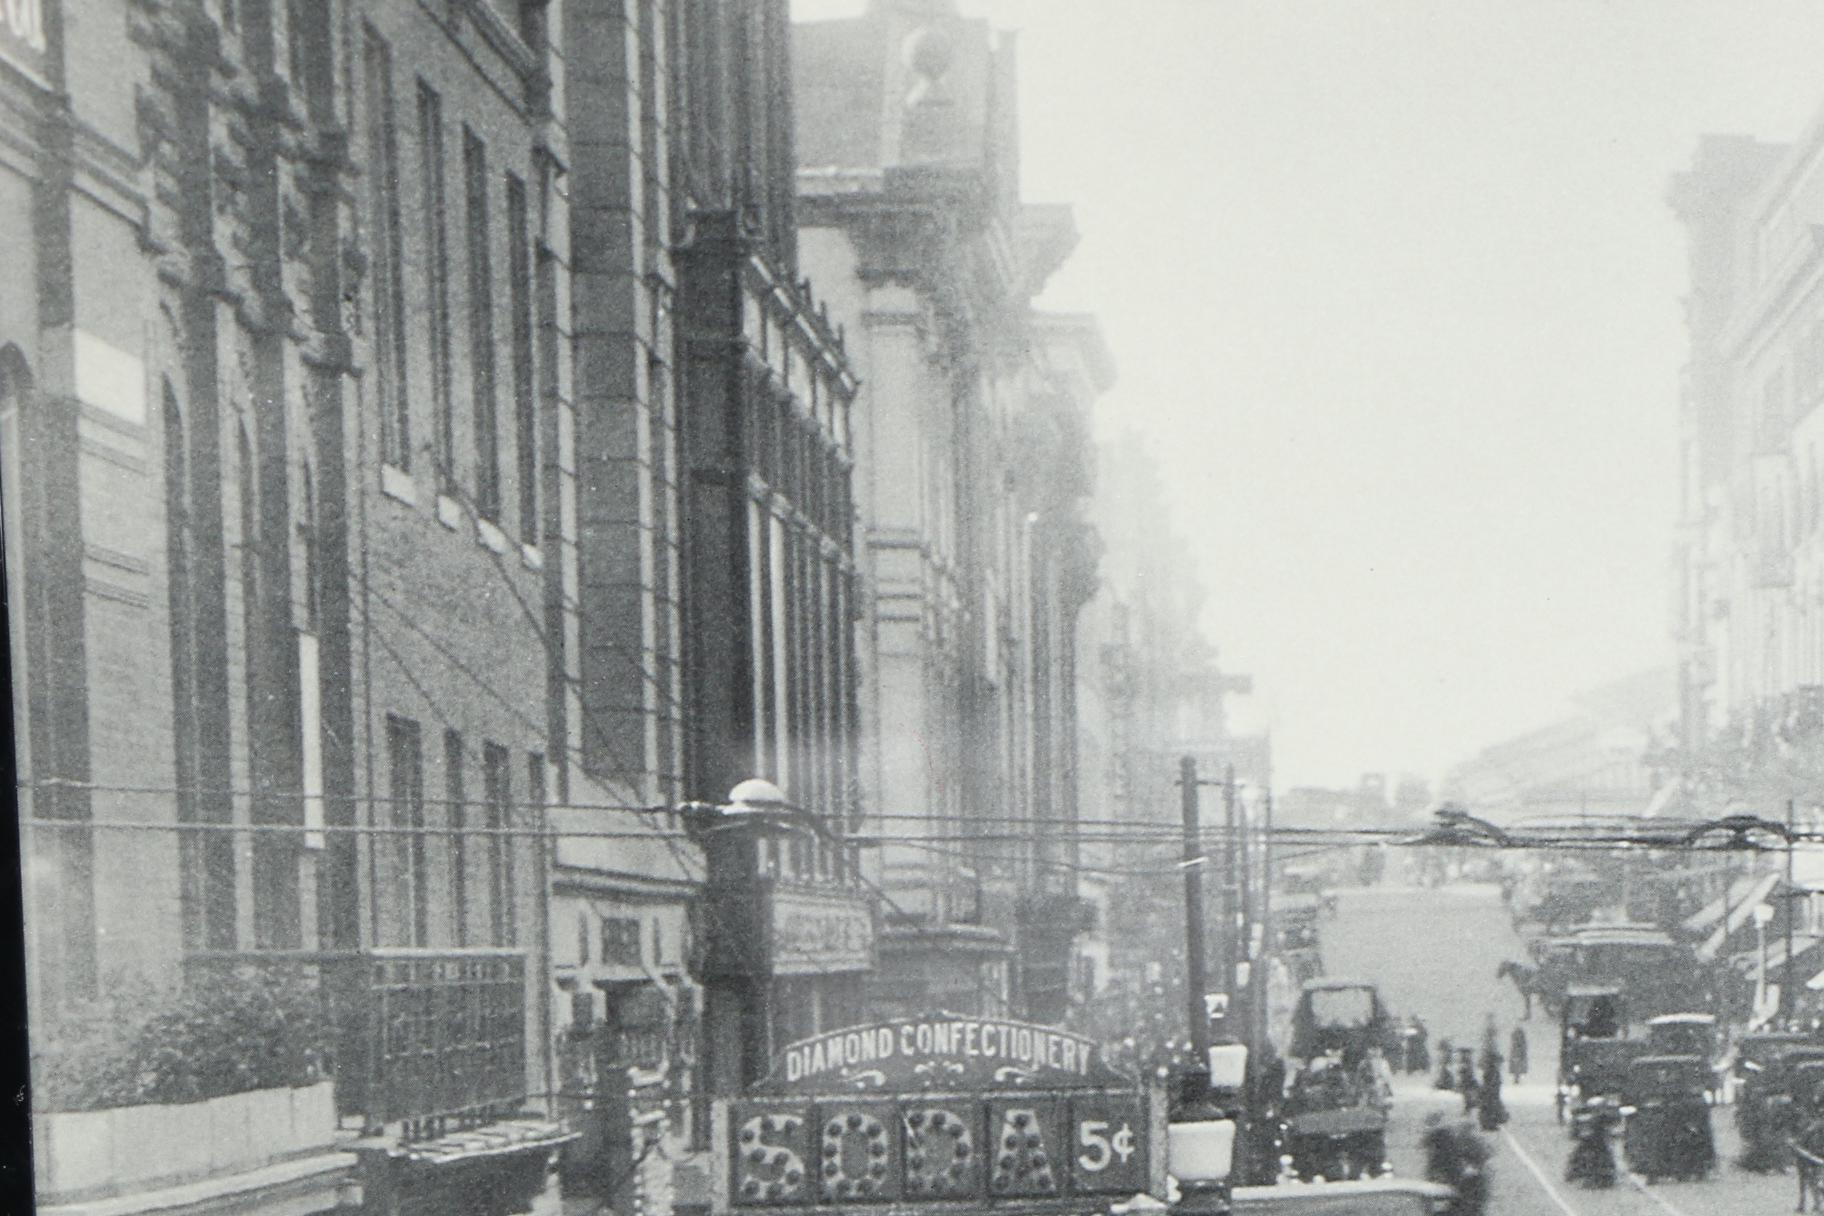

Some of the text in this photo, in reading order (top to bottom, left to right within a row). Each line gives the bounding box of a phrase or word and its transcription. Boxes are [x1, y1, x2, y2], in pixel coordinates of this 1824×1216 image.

[786, 1022, 1091, 1082] DIAMOND CONFECTIONERY
[737, 1108, 1056, 1200] SODA
